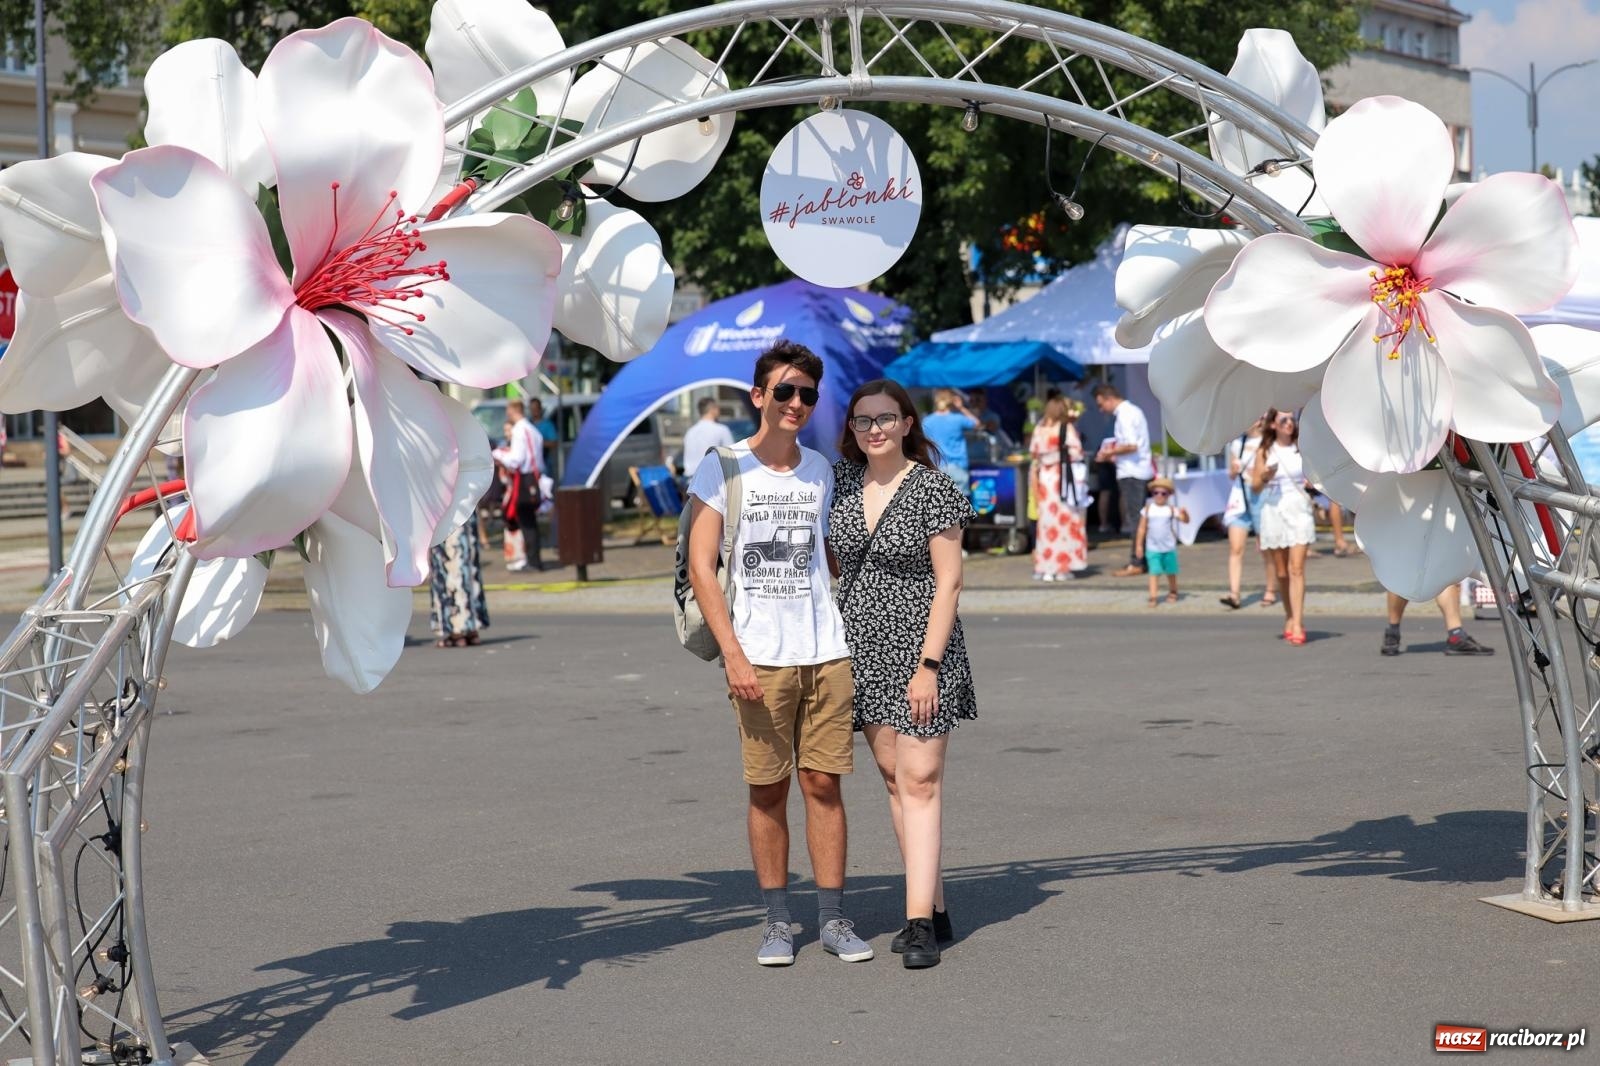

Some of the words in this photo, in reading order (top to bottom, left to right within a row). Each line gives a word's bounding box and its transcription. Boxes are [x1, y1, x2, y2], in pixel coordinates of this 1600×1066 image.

[769, 177, 914, 229] #jabłonki
[821, 215, 876, 225] SWAWOLE
[747, 490, 794, 505] Tropical
[797, 491, 817, 502] Side
[746, 510, 769, 523] WILD
[772, 510, 819, 523] ADVENTURE
[762, 584, 797, 594] SUMMER
